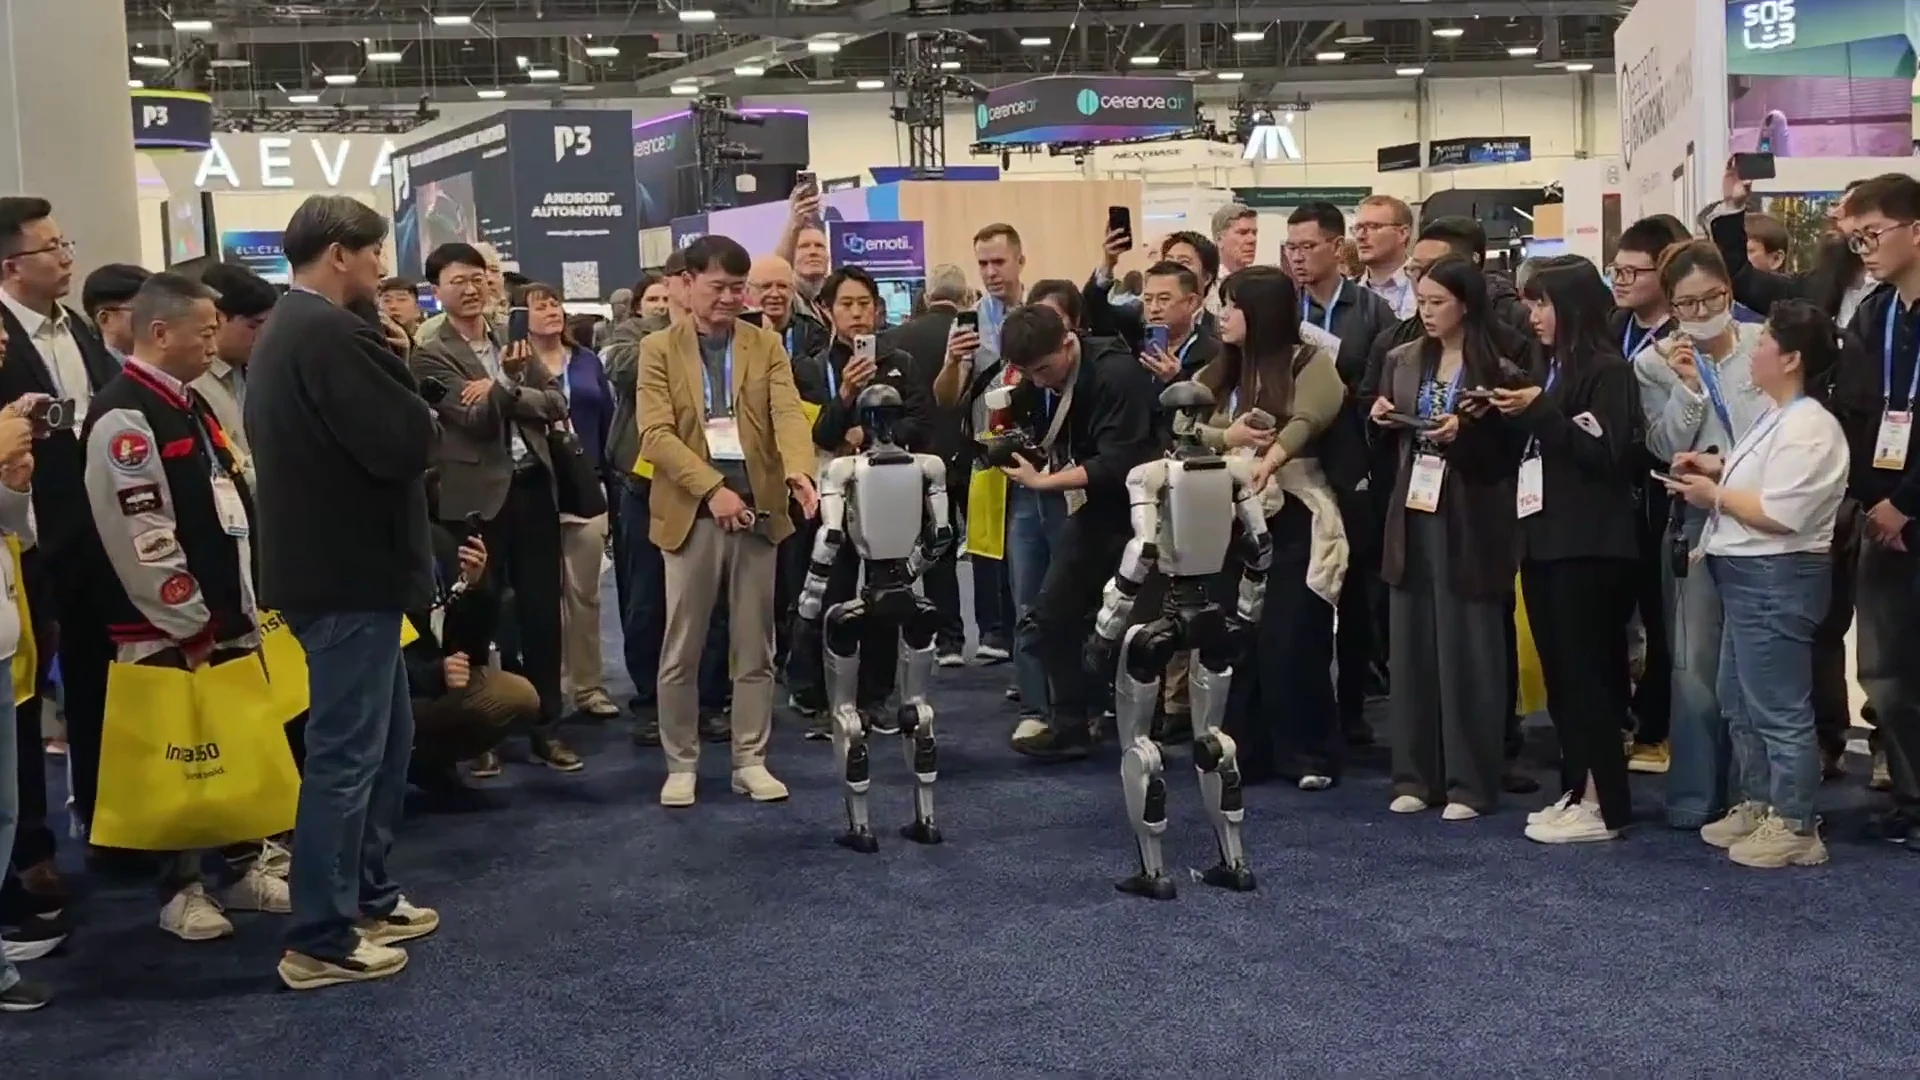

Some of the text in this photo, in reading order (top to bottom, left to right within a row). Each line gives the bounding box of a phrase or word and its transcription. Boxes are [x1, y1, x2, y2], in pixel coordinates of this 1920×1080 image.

[1743, 0, 1796, 27] SOS
[1100, 95, 1165, 109] cerence
[143, 105, 168, 128] P3
[554, 125, 591, 163] P3
[531, 204, 623, 218] AUTOMOTIVE
